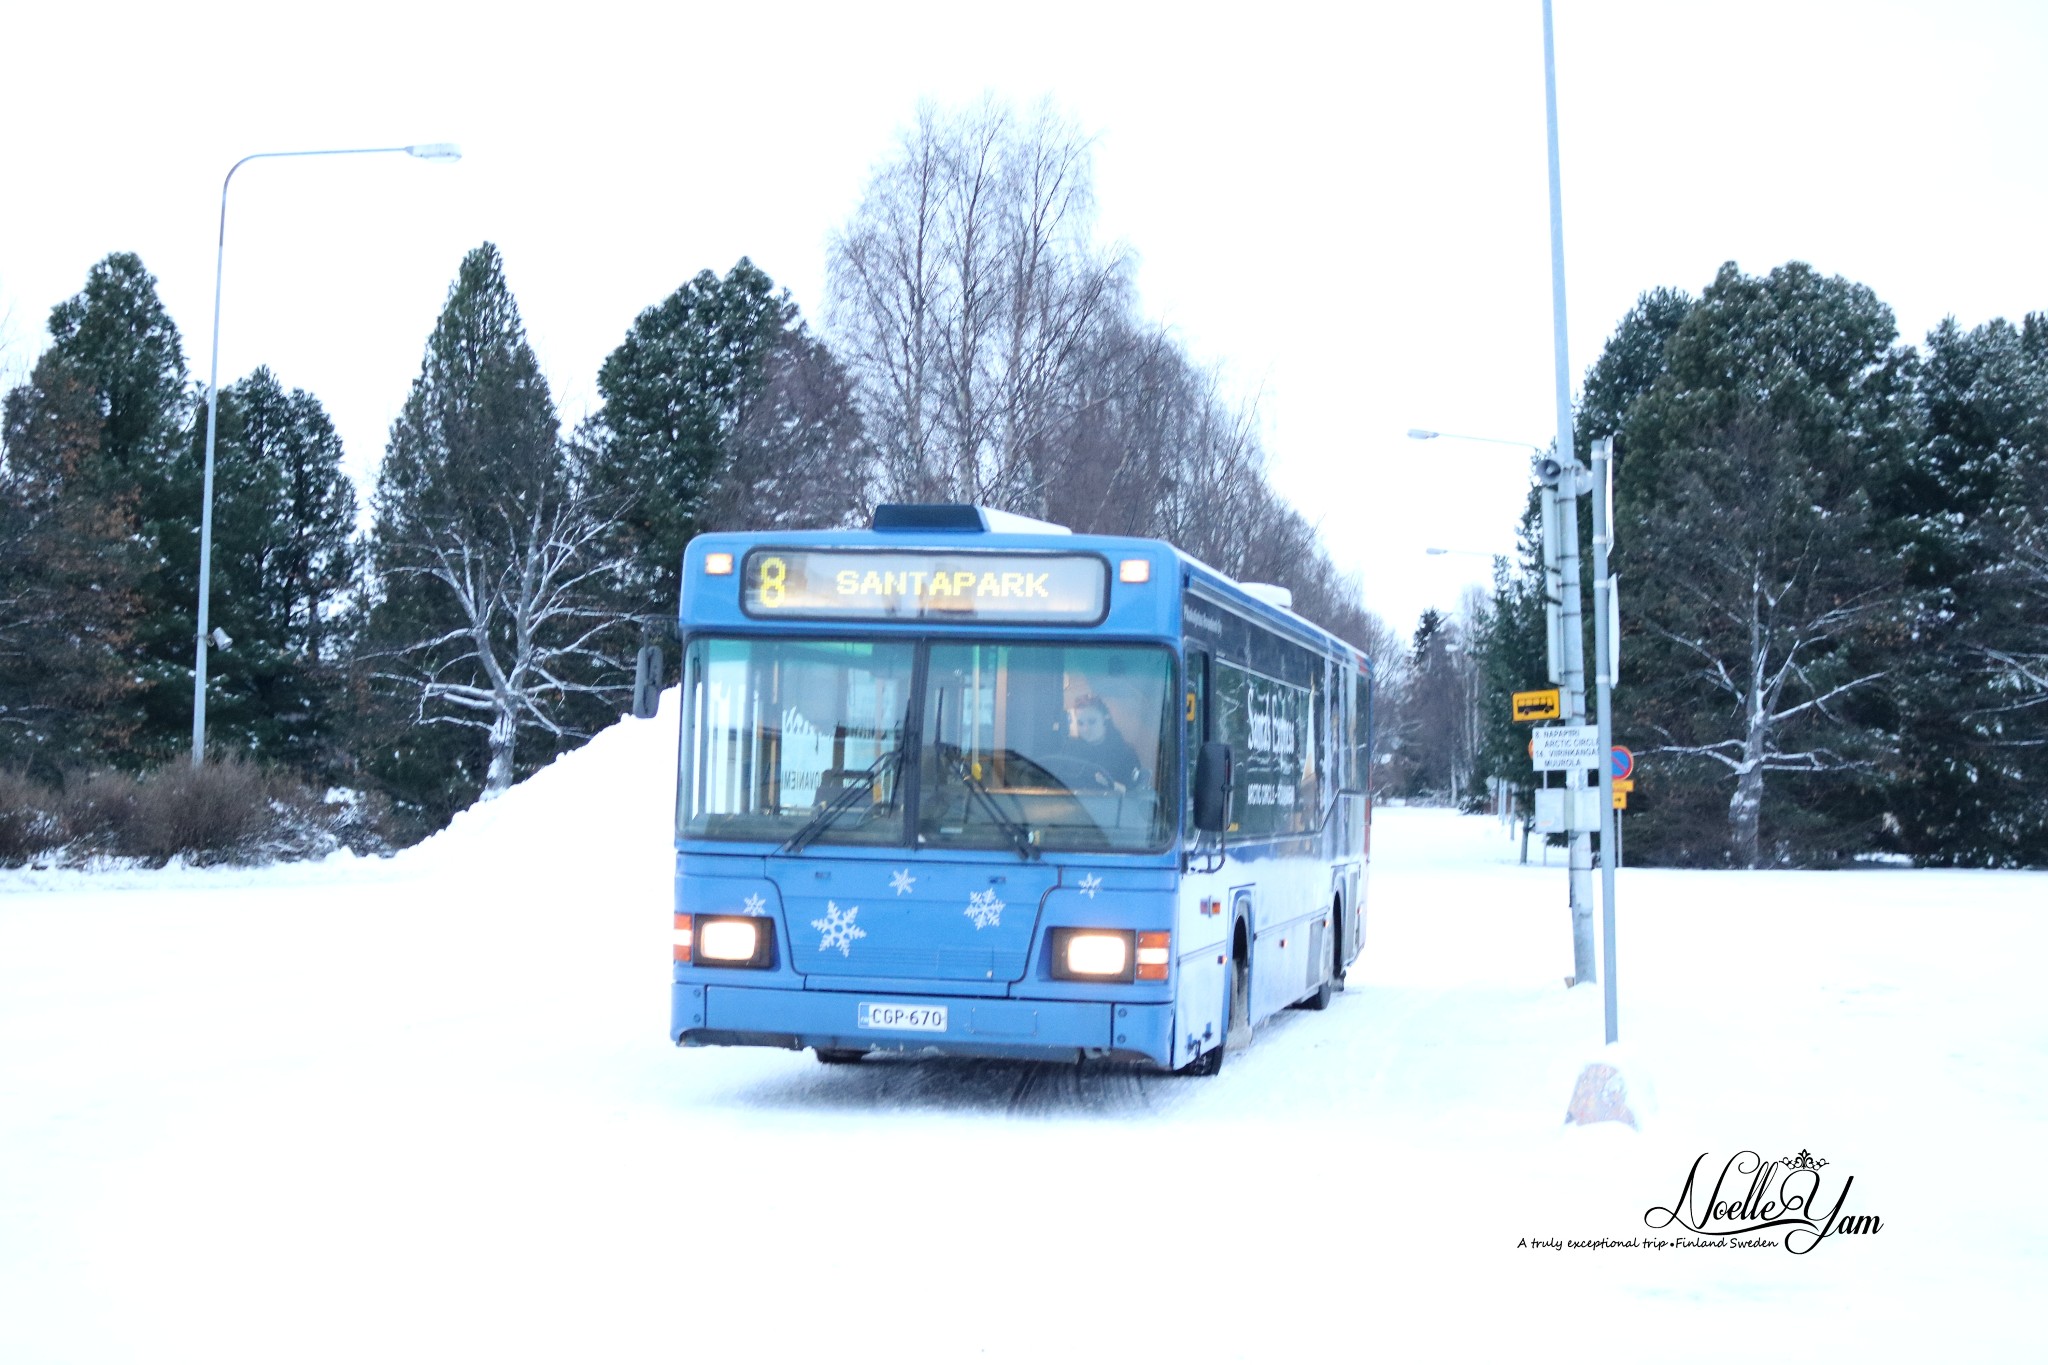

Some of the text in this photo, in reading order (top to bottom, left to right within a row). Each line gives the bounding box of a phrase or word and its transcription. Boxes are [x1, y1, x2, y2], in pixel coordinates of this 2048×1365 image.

[760, 557, 1050, 609] 8 SANTAPARK
[1544, 739, 1571, 748] ARCTIC
[1544, 758, 1581, 767] MUUROLA
[872, 1008, 942, 1027] CGP-670
